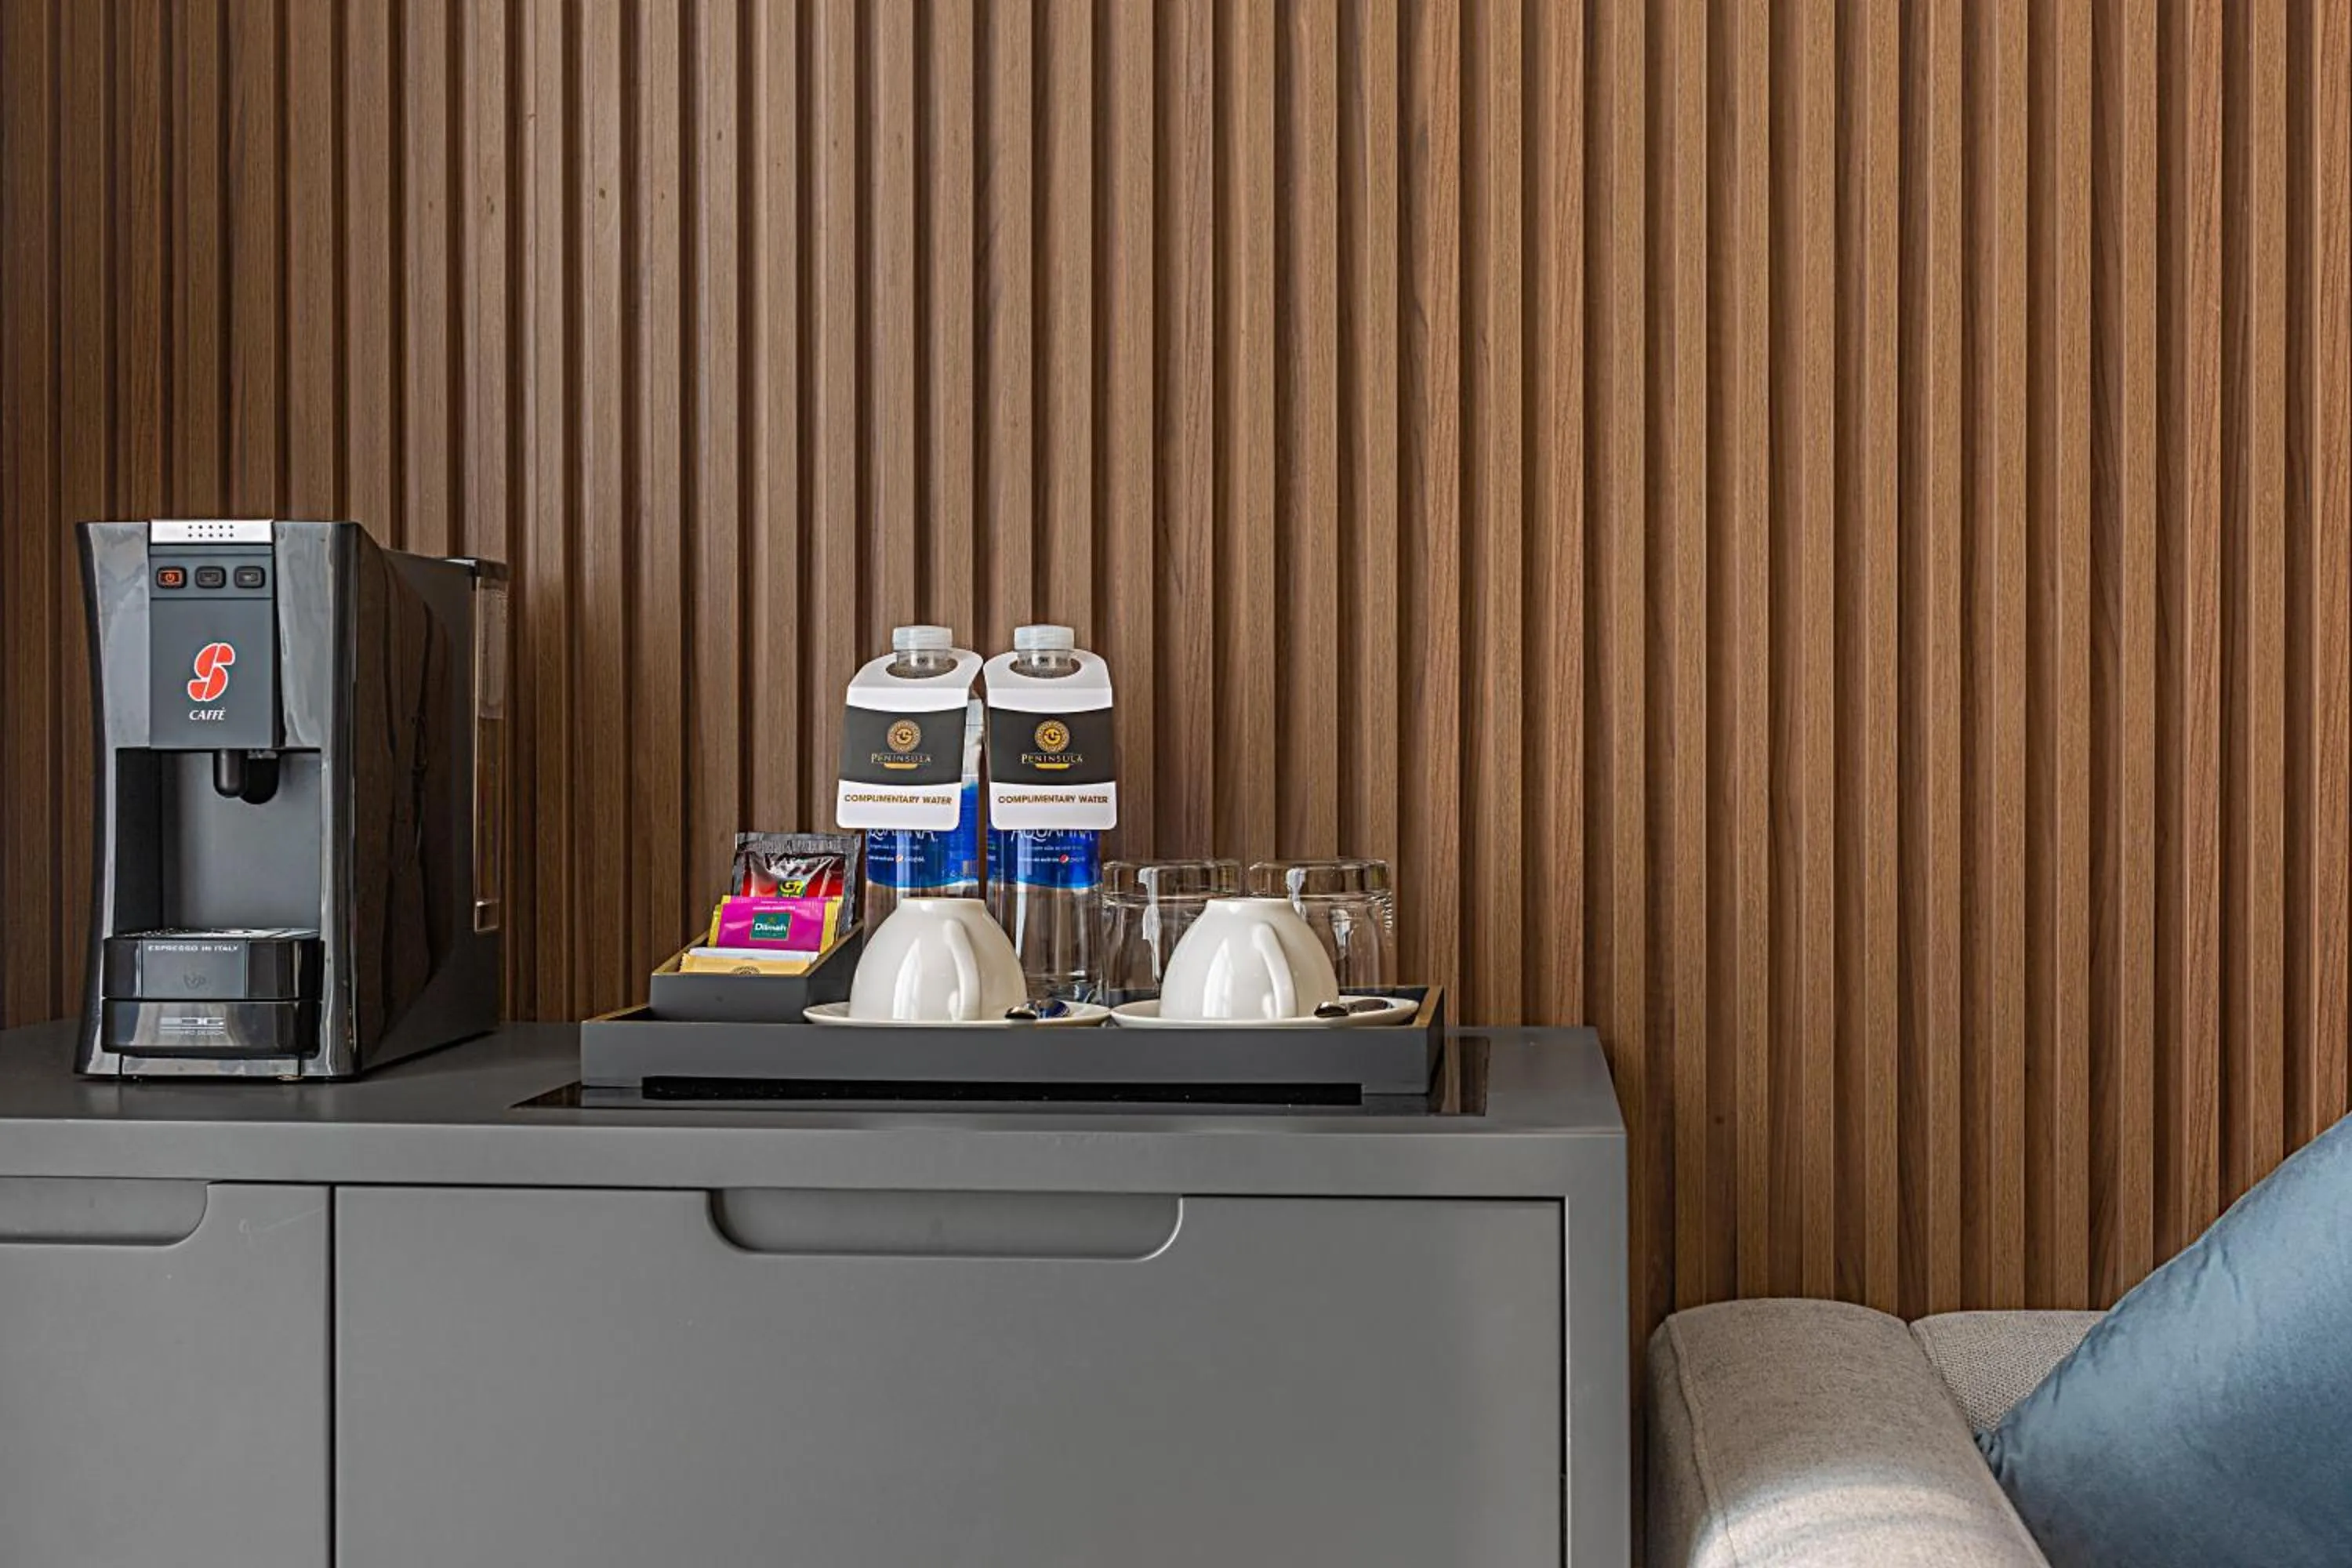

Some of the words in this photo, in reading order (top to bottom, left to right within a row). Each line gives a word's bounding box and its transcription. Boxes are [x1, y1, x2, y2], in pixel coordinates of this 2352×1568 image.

[844, 794, 919, 804] COMPLIMENTARY
[922, 796, 953, 804] WATER
[998, 795, 1076, 804] COMPLIMENTARY
[1078, 795, 1108, 804] WATER
